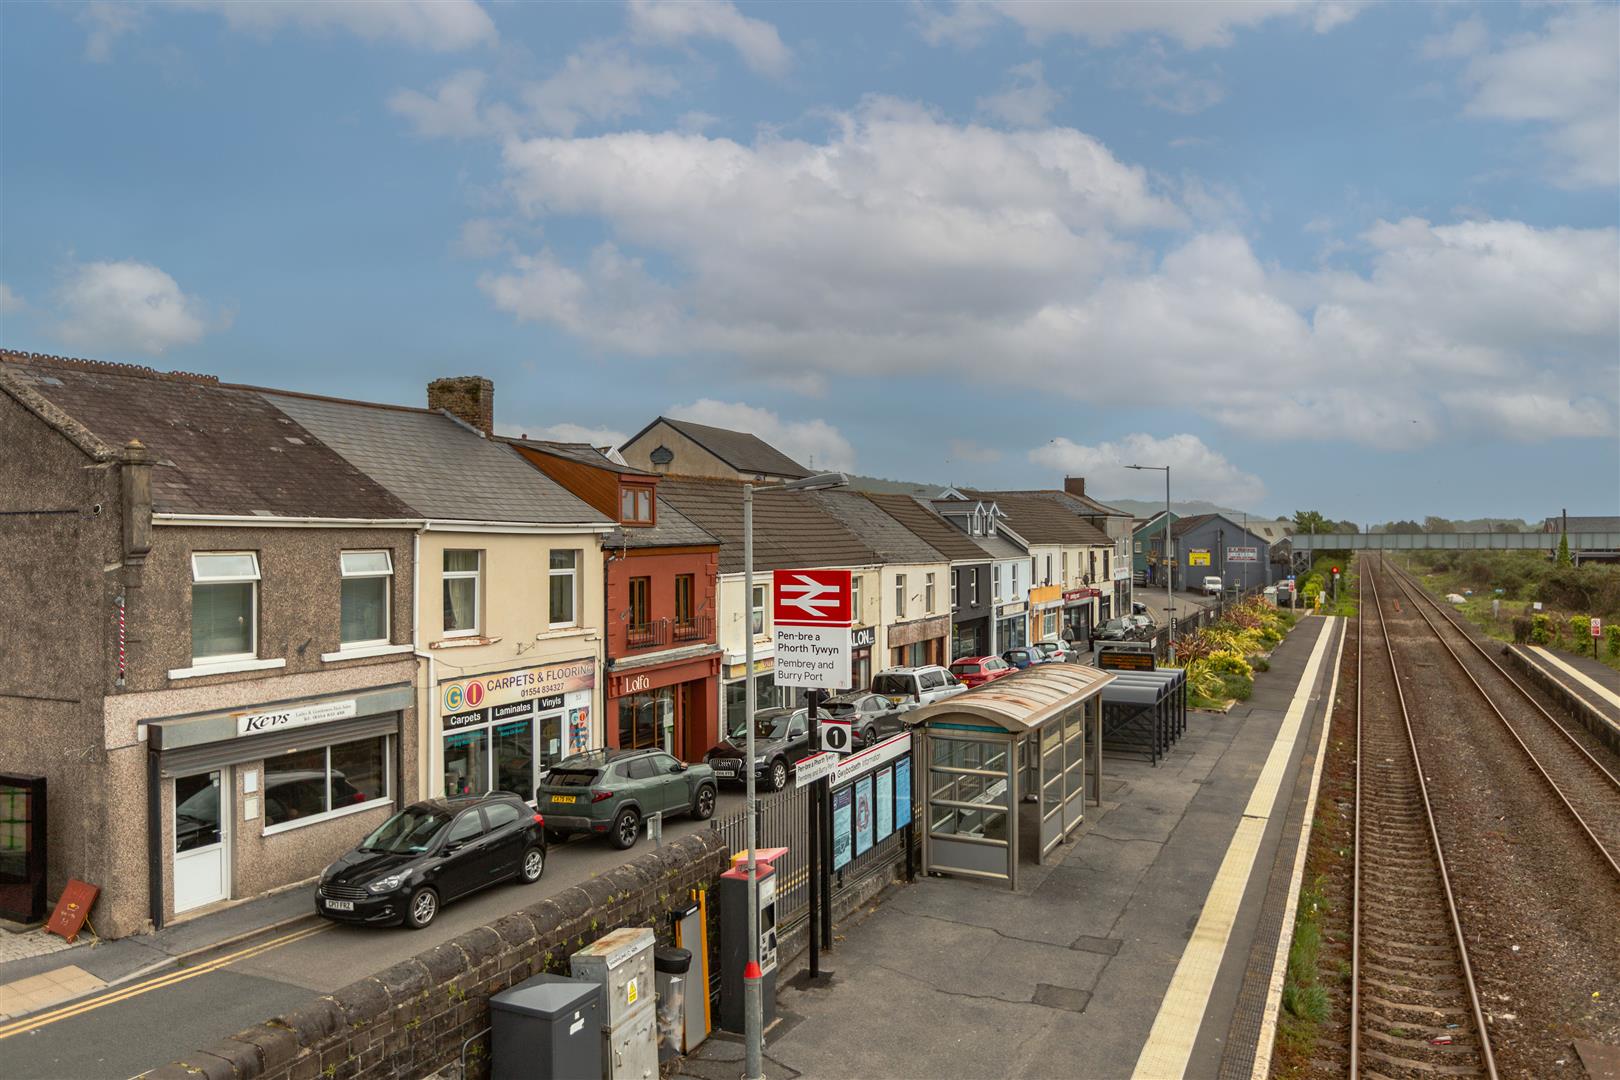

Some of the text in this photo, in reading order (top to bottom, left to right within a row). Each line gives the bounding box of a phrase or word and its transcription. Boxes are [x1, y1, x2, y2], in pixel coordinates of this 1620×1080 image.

[778, 631, 813, 641] Pen-bre
[778, 643, 839, 656] Phorth Tywyn
[778, 658, 816, 670] Pembrey
[817, 661, 834, 670] and
[487, 673, 535, 692] CARPETS
[536, 672, 544, 683] &
[546, 664, 594, 682] FLOORING
[778, 671, 823, 682] Burry Port
[520, 682, 565, 698] 01554 834327
[450, 696, 562, 726] Carpets Laminates Vinyls
[244, 713, 290, 732] Kevs
[832, 729, 838, 746] 1
